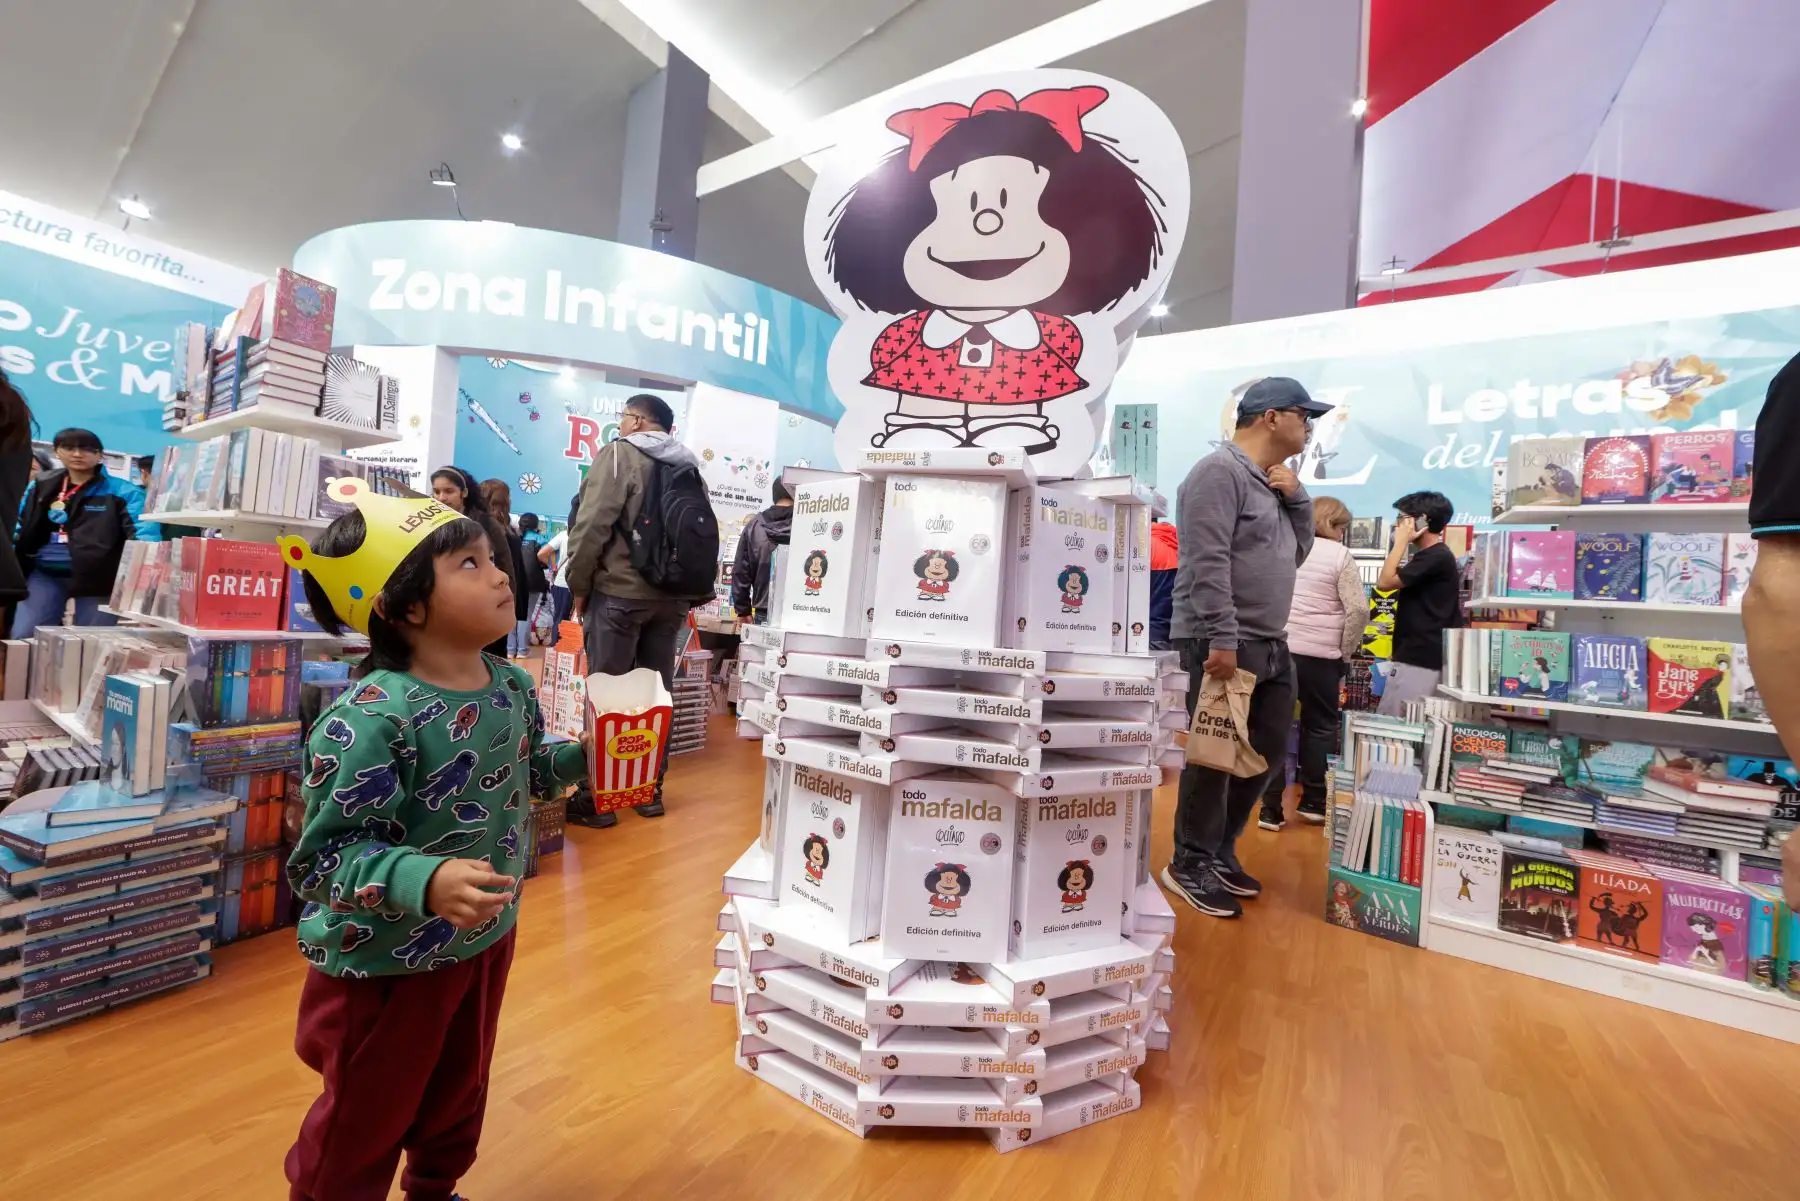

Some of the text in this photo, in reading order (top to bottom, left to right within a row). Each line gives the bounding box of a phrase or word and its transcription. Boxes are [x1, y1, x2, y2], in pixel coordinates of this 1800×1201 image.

[370, 258, 768, 366] Zona Infantil
[36, 306, 172, 362] Juve
[45, 347, 109, 390] &
[1427, 375, 1670, 425] Letras
[1664, 432, 1726, 445] PERROS
[866, 451, 916, 462] mafalda
[1422, 431, 1499, 469] del
[1523, 451, 1572, 468] BOVAR
[894, 481, 917, 492] todo
[745, 495, 763, 504] libro
[796, 493, 850, 515] mafalda
[798, 492, 811, 500] todo
[1041, 496, 1058, 508] todo
[398, 505, 440, 534] LEXUS
[1041, 504, 1108, 532] mafalda
[1579, 542, 1635, 553] WOOLF
[1655, 541, 1718, 552] WOOLF
[206, 574, 282, 597] GREAT
[792, 603, 831, 614] Edición definitiva
[895, 608, 969, 623] Edición definitiva
[1045, 621, 1097, 631] Edición definitiva
[1663, 643, 1698, 651] CHARLOTTE
[977, 655, 1035, 670] mafalda
[1583, 641, 1639, 671] ALICIA
[837, 665, 880, 682] mafalda
[1658, 663, 1700, 682] Jane
[1115, 684, 1155, 697] mafalda
[1200, 691, 1225, 704] Grupo
[1656, 679, 1696, 699] Eyre
[106, 695, 133, 716] mami
[973, 703, 1031, 719] mafalda
[839, 711, 882, 730] mafalda
[617, 734, 646, 746] POP
[1111, 731, 1152, 743] mafalda
[1195, 726, 1209, 736] en
[1212, 728, 1229, 740] los
[1453, 727, 1506, 741] ANTOLOGÍA
[616, 740, 652, 754] CORN
[839, 759, 882, 778] mafalda
[972, 752, 1029, 768] mafalda
[479, 764, 512, 791] UFO
[1112, 773, 1152, 787] mafalda
[794, 770, 852, 806] mafalda
[902, 789, 927, 800] todo
[1039, 795, 1059, 805] todo
[901, 797, 1002, 822] mafalda
[1038, 799, 1117, 822] mafalda
[168, 832, 188, 841] mami
[1438, 838, 1499, 855] EL ARTE DE
[1437, 858, 1457, 868] SUN
[1438, 848, 1498, 866] LA GUERRA
[77, 871, 137, 888] amo mami
[1511, 862, 1575, 880] LA GUERRA
[791, 884, 810, 899] Edición
[1511, 875, 1575, 892] MUNDOS
[1594, 872, 1651, 895] ILÍADA
[1667, 892, 1745, 920] MUJERCITAS
[63, 912, 88, 922] mami
[1363, 904, 1411, 926] TEJAS
[906, 926, 982, 939] Edición definitiva
[1043, 919, 1102, 934] Edición definitiva
[1363, 915, 1410, 935] VERDES
[61, 933, 122, 952] amo mami
[60, 963, 122, 983] amo mami
[832, 961, 880, 987] mafalda
[1104, 963, 1145, 982] mafalda
[57, 991, 119, 1013] amo mami
[823, 1011, 869, 1039] mafalda
[983, 1011, 1039, 1024] mafalda
[1100, 1009, 1141, 1028] mafalda
[825, 1055, 871, 1084] mafalda
[978, 1061, 1035, 1074] mafalda
[1097, 1054, 1138, 1075] mafalda
[812, 1095, 856, 1128] mafalda
[974, 1110, 1031, 1123] mafalda
[1092, 1098, 1133, 1119] mafalda
